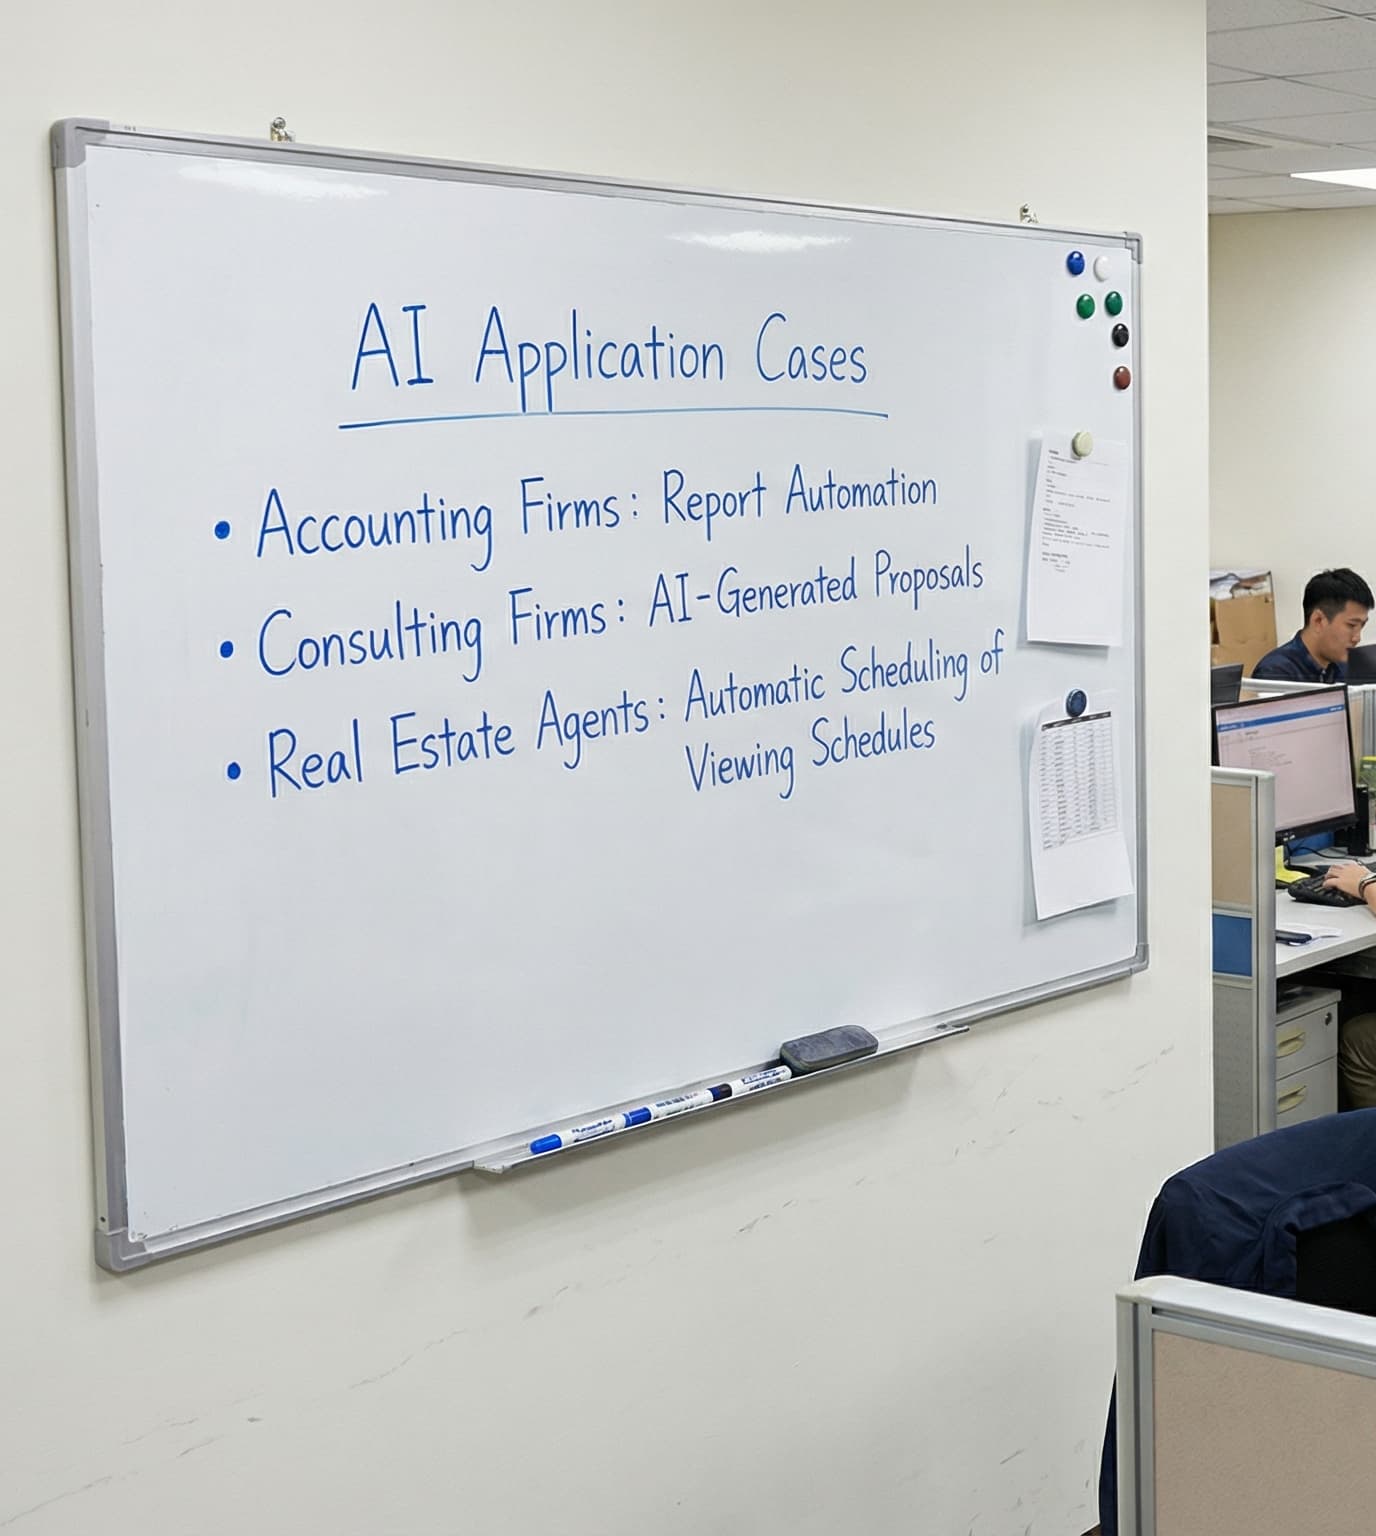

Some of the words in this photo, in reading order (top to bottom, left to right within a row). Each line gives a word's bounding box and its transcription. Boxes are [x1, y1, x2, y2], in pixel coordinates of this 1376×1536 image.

[351, 302, 434, 390] AI
[475, 305, 725, 415] Application
[757, 312, 868, 384] Cases
[256, 487, 494, 573] Accounting
[520, 475, 640, 535] Firms:
[663, 468, 767, 542] Report
[785, 463, 938, 514] Automation
[258, 599, 484, 684] Consulting
[508, 586, 626, 645] Firms:
[648, 555, 858, 627] AI-Generated
[874, 543, 985, 611] Proposals
[267, 717, 364, 799] Real
[389, 710, 516, 776] Estate
[536, 689, 667, 770] Agents:
[684, 663, 827, 722] Automatic
[839, 637, 969, 703] Scheduling
[979, 627, 1005, 676] of
[684, 741, 796, 801] Viewing
[809, 706, 937, 768] Schedules
